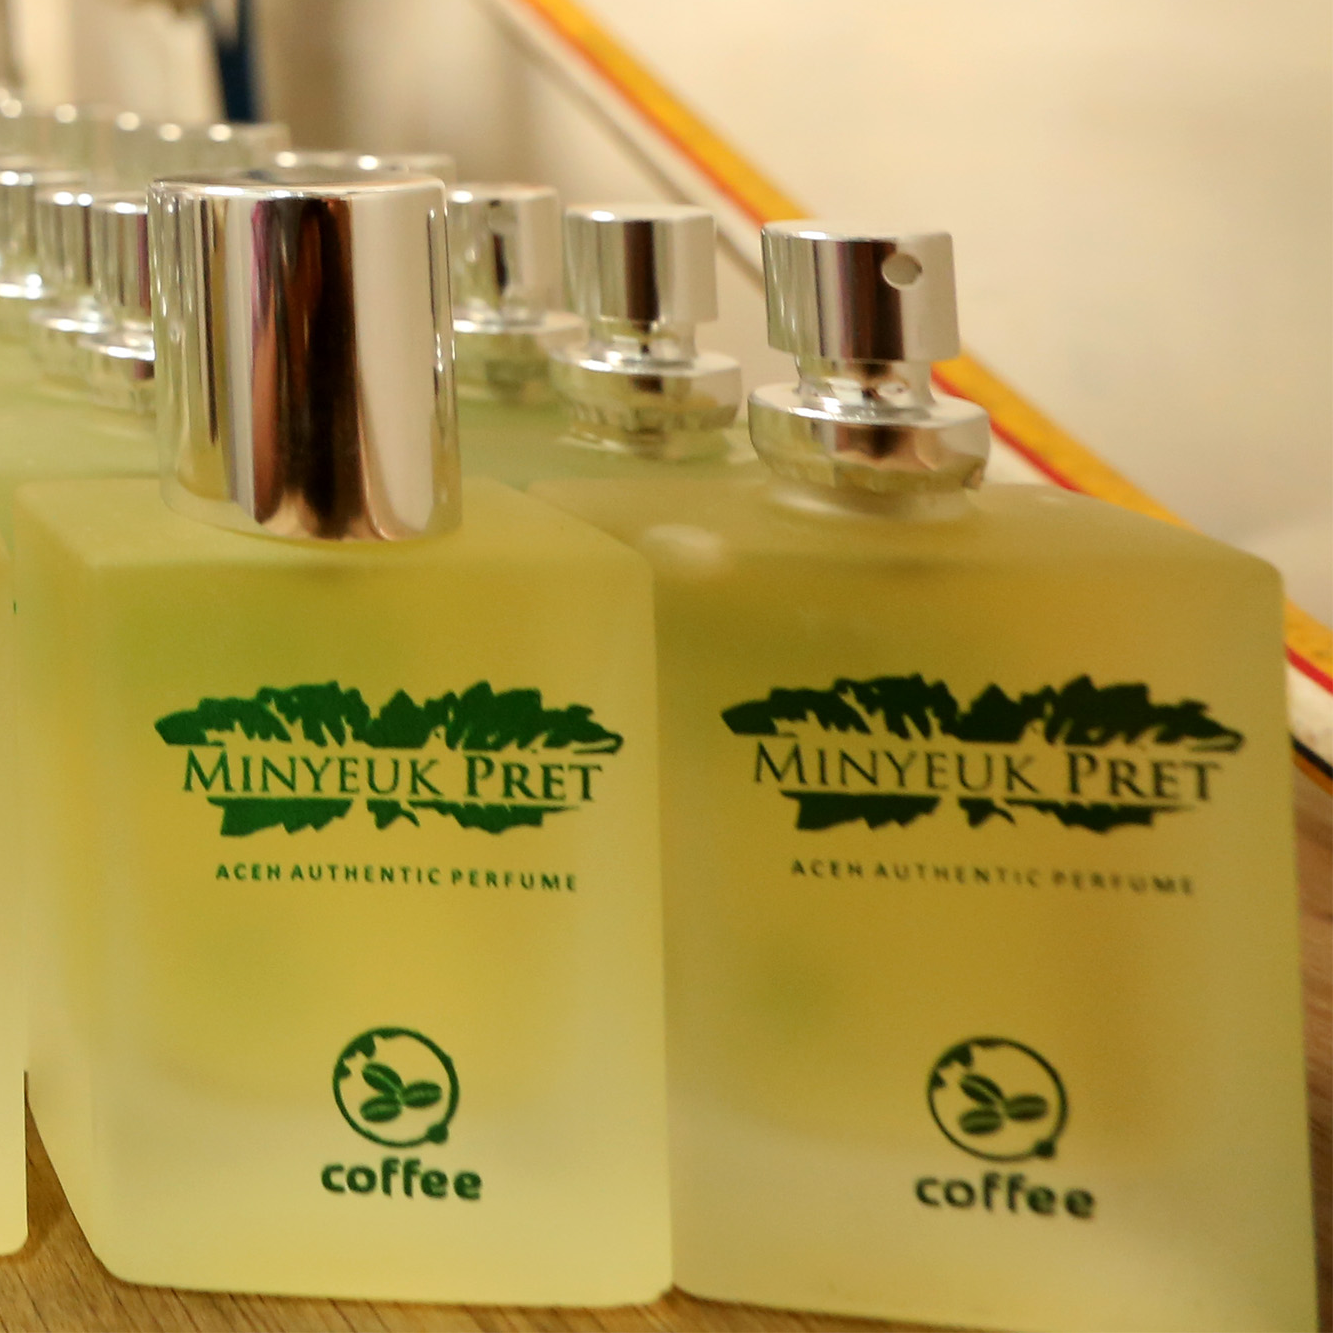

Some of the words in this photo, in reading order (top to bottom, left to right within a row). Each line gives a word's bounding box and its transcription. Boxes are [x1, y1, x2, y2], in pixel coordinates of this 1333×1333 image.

[182, 750, 443, 798] MINYEUK
[463, 756, 603, 802] PRET
[753, 742, 1041, 794] MINYEUK
[1065, 752, 1223, 802] PRET
[215, 863, 281, 881] ACEH
[290, 864, 441, 886] AUTHENTIC
[451, 870, 577, 892] PERFUME
[790, 859, 863, 879] ACEH
[874, 862, 1041, 888] AUTHENTIC
[1051, 871, 1195, 896] PERFUME
[320, 1158, 483, 1201] coffee
[914, 1171, 1096, 1219] coffee
